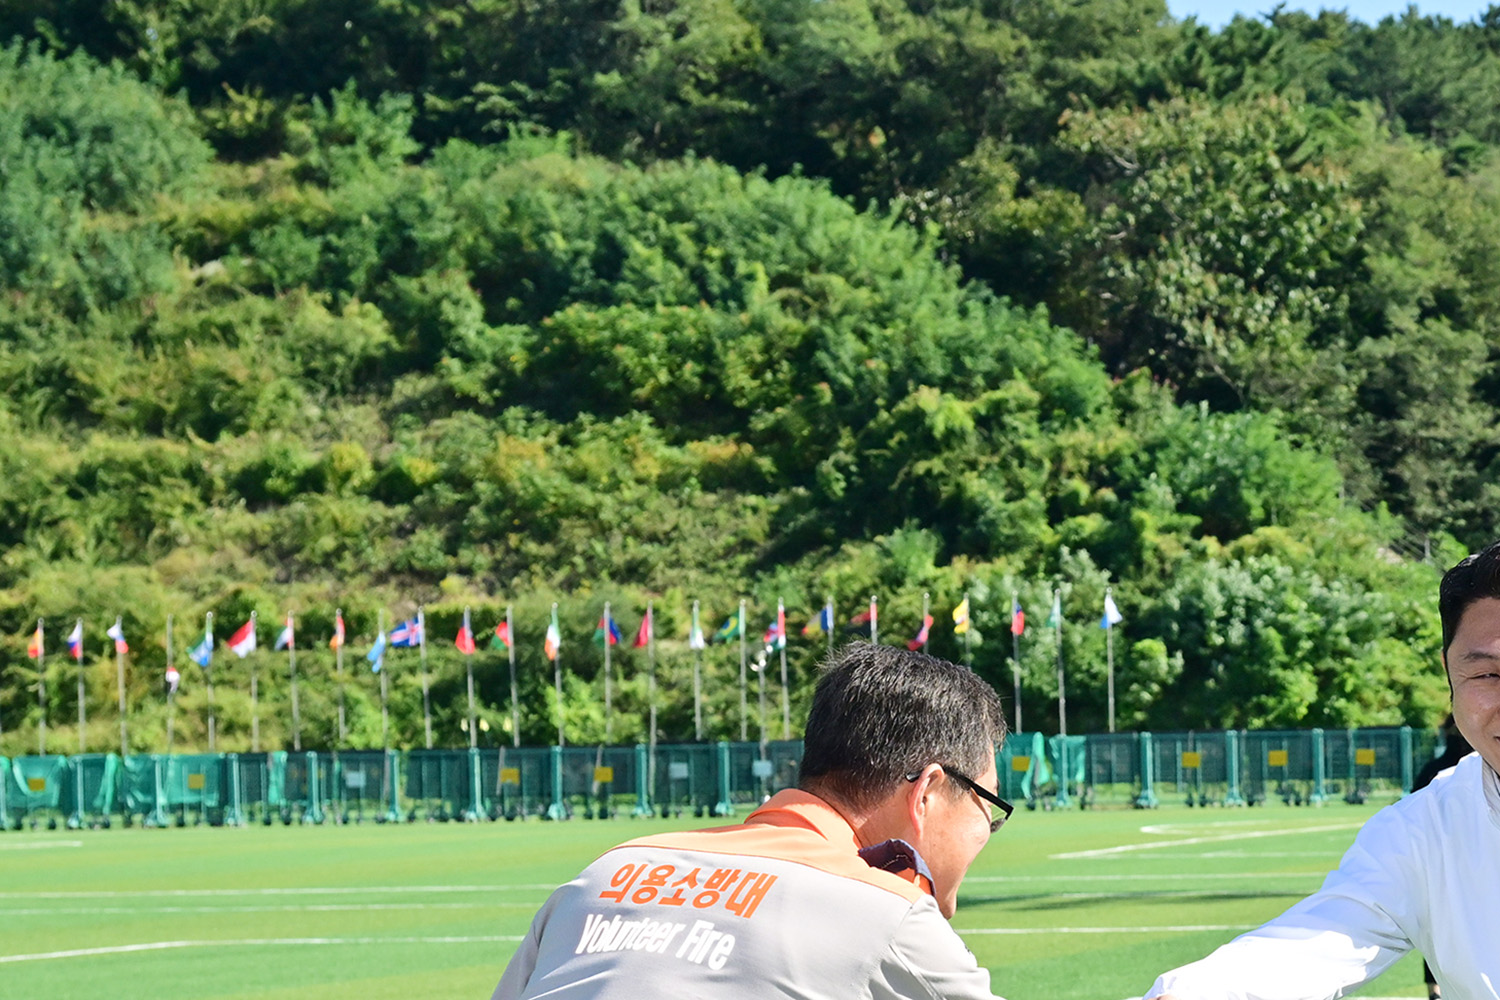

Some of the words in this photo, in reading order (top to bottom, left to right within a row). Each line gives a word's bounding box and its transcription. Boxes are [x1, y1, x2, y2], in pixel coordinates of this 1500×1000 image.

[598, 863, 779, 919] 의용소방대
[575, 914, 685, 954] Volunteer
[675, 919, 736, 971] Fire
